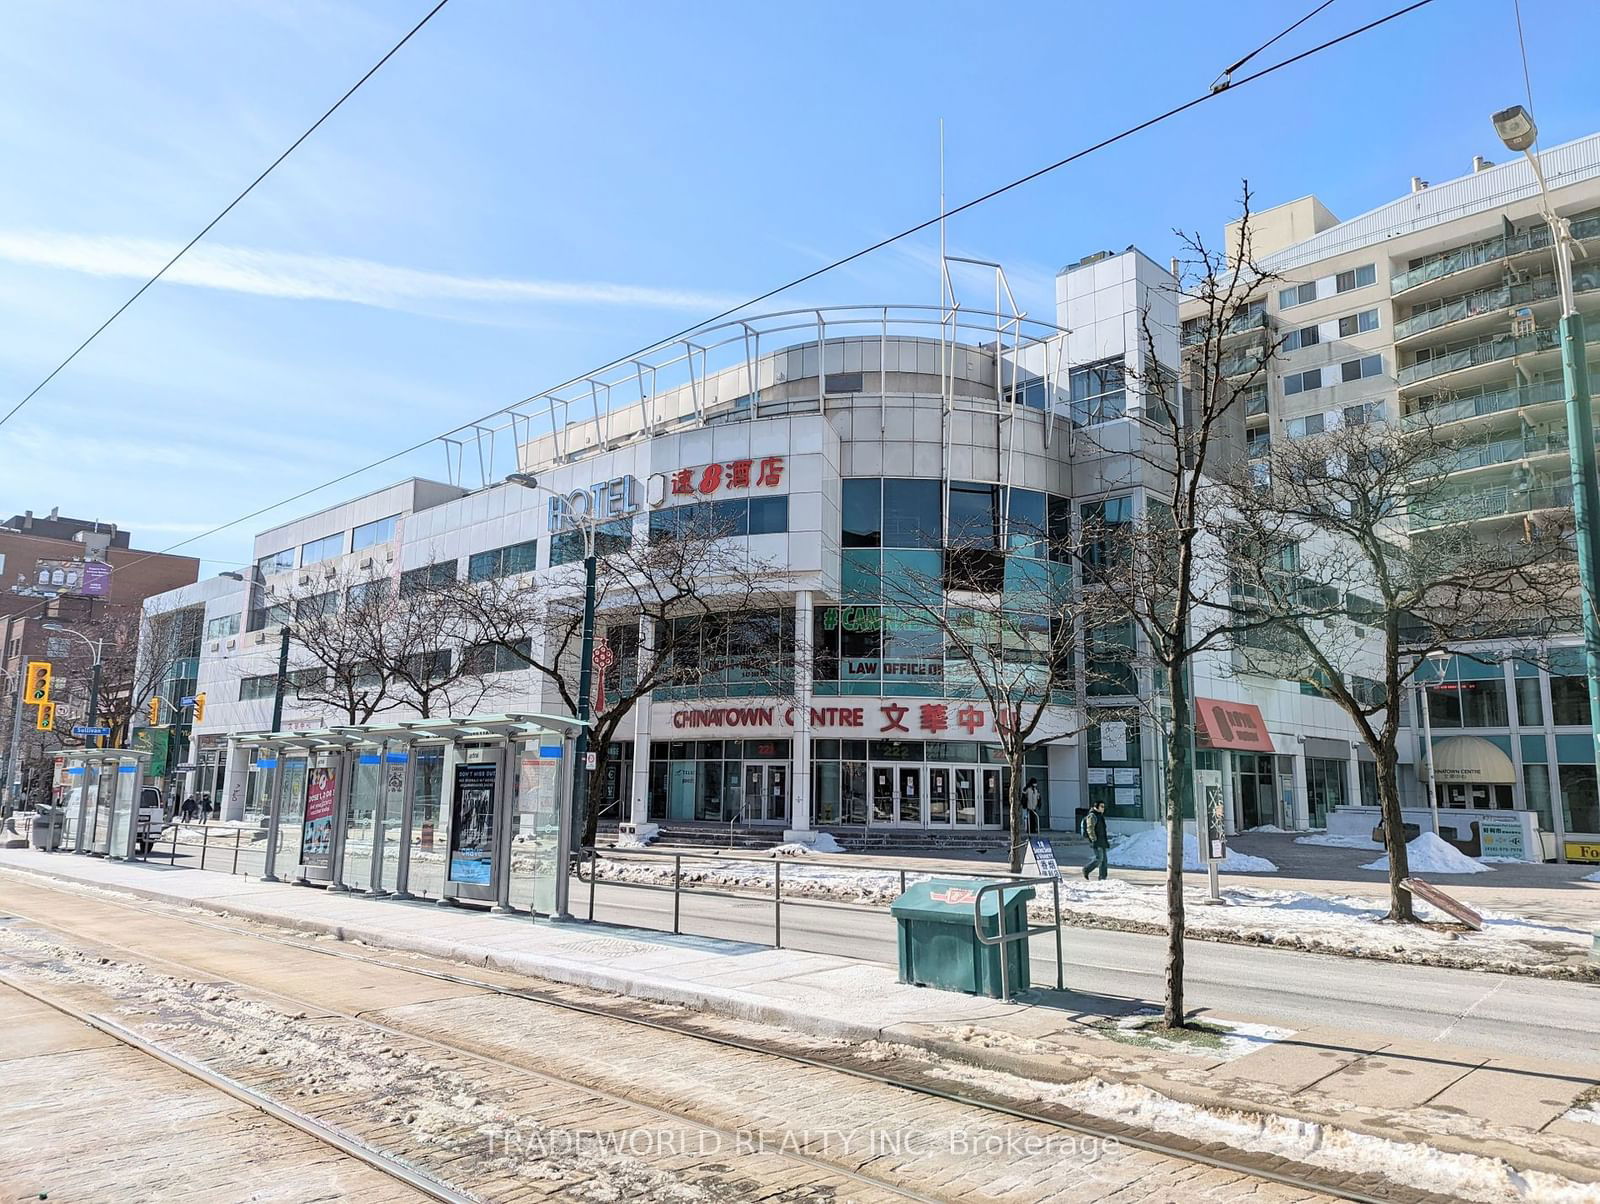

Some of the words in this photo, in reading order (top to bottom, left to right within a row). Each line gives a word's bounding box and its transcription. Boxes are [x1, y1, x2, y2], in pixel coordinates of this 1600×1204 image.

[671, 456, 785, 495] 速8酒店
[547, 474, 640, 532] HOTEL
[848, 661, 878, 675] LAW
[883, 662, 926, 675] OFFICE
[673, 708, 773, 729] CHINATOWN
[785, 707, 864, 728] CNTRE
